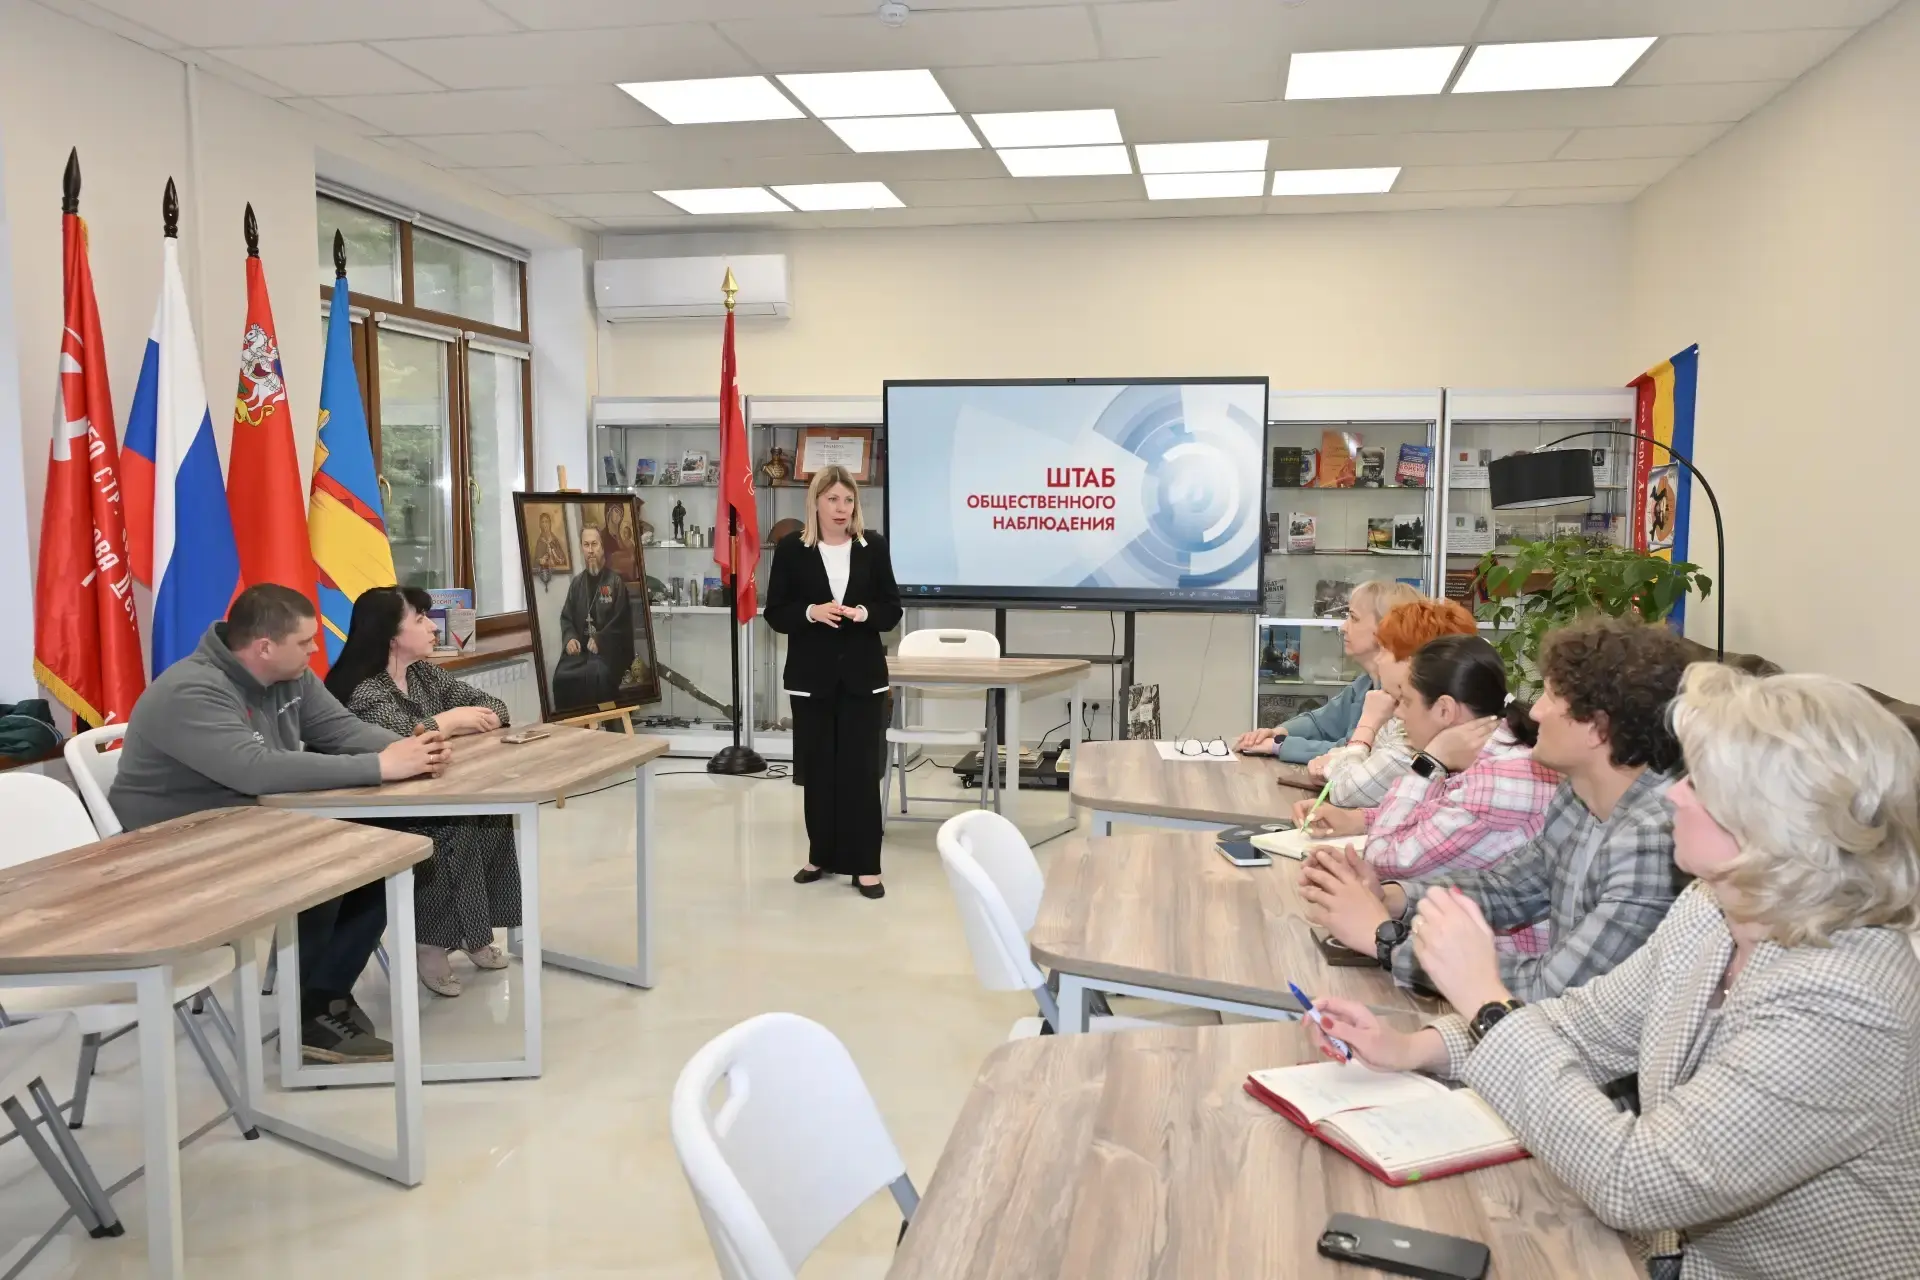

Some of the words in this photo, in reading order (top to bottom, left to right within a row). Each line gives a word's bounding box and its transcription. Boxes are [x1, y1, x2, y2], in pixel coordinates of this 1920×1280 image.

[1046, 467, 1116, 488] ШТАБ
[967, 495, 1116, 510] ОБЩЕСТВЕННОГО
[993, 515, 1115, 531] НАБЛЮДЕНИЯ
